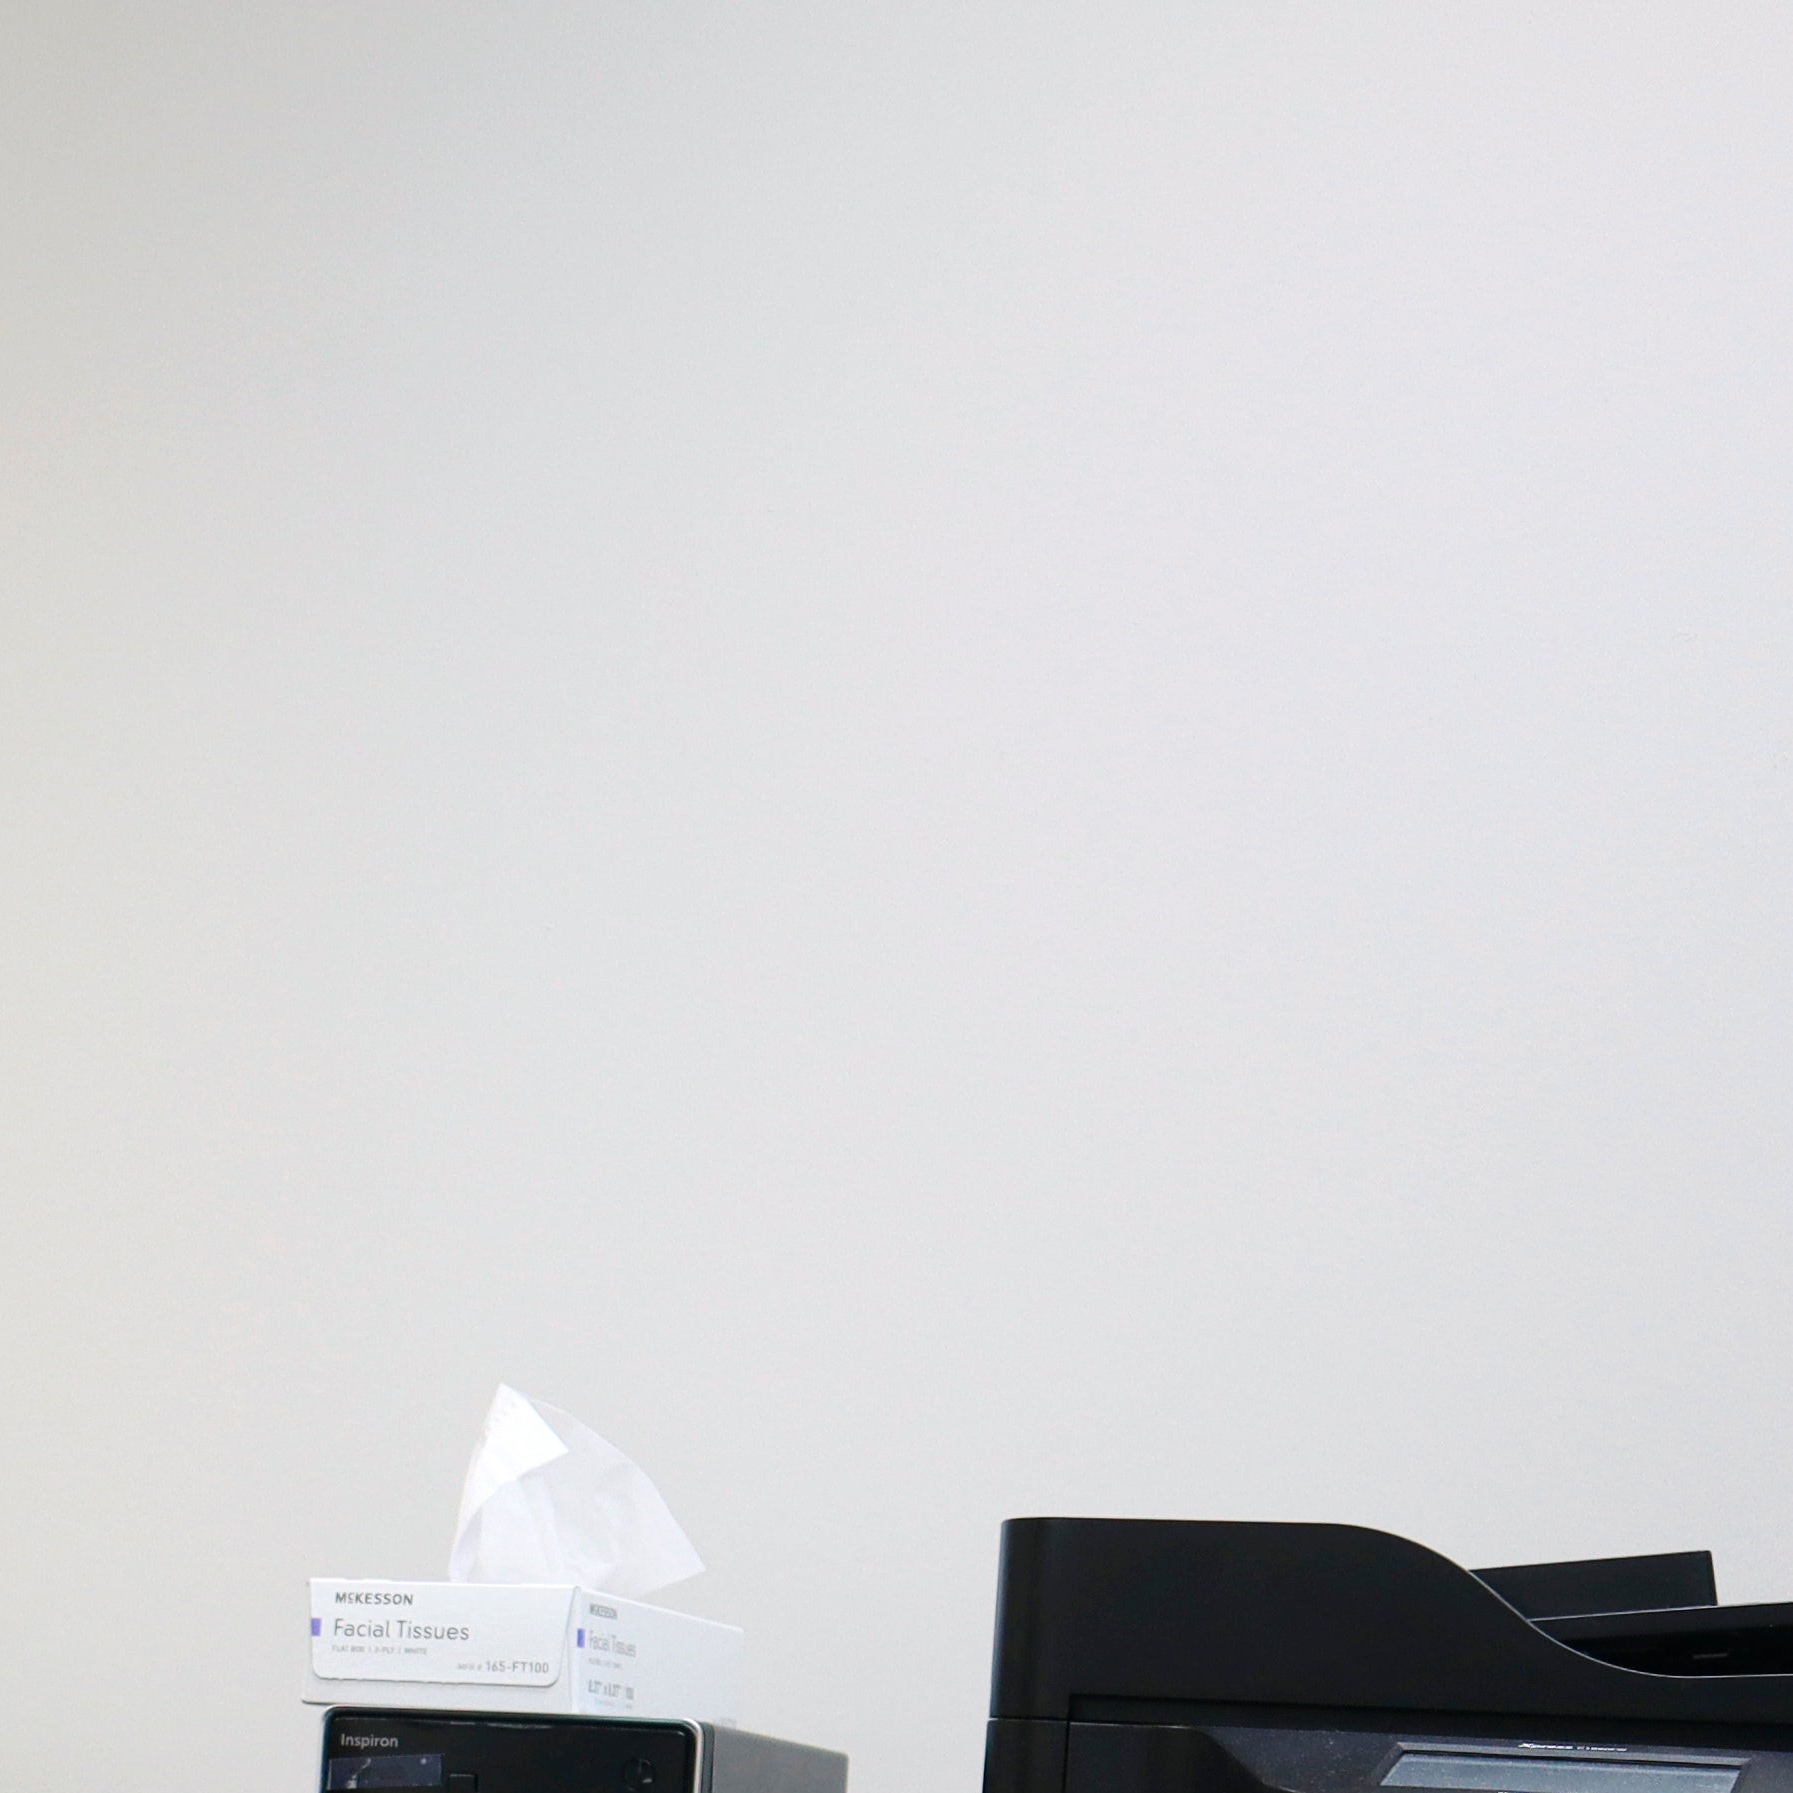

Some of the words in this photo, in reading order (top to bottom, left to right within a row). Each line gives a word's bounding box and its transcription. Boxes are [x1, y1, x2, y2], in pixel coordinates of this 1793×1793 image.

[334, 1617, 391, 1638] Facial
[397, 1620, 470, 1641] Tissues
[486, 1660, 550, 1674] 165-FT100
[340, 1733, 399, 1749] Inspiron
